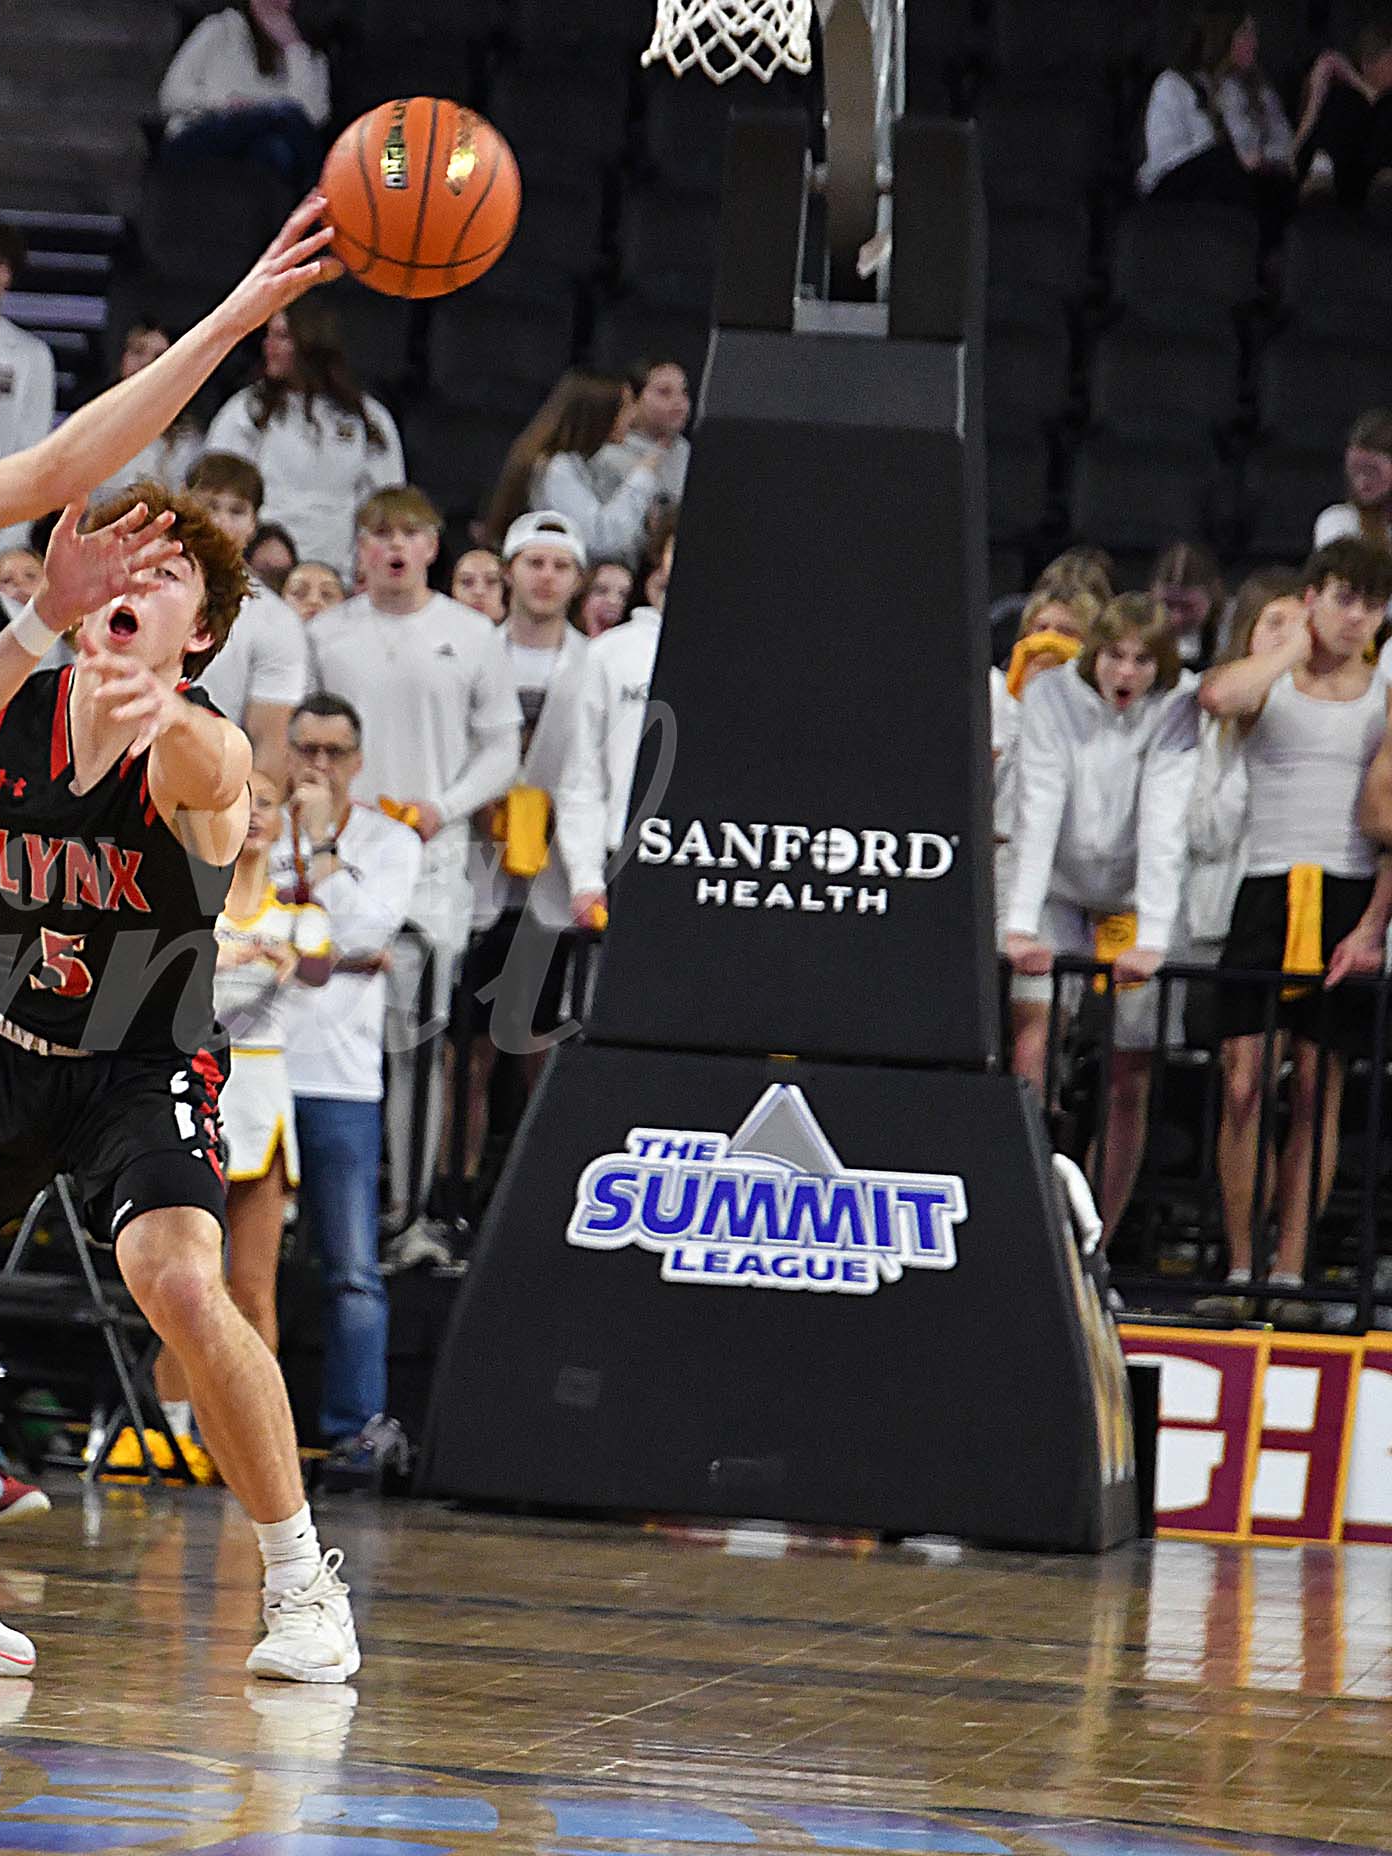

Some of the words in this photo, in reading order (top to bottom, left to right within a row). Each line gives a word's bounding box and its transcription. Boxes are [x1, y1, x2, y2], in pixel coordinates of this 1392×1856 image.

[637, 817, 955, 879] SANFORD
[696, 877, 888, 914] HEALTH
[29, 926, 93, 998] 5
[635, 1136, 720, 1163] THE
[583, 1169, 949, 1252] SUMMIT
[670, 1246, 870, 1284] LEAGUE
